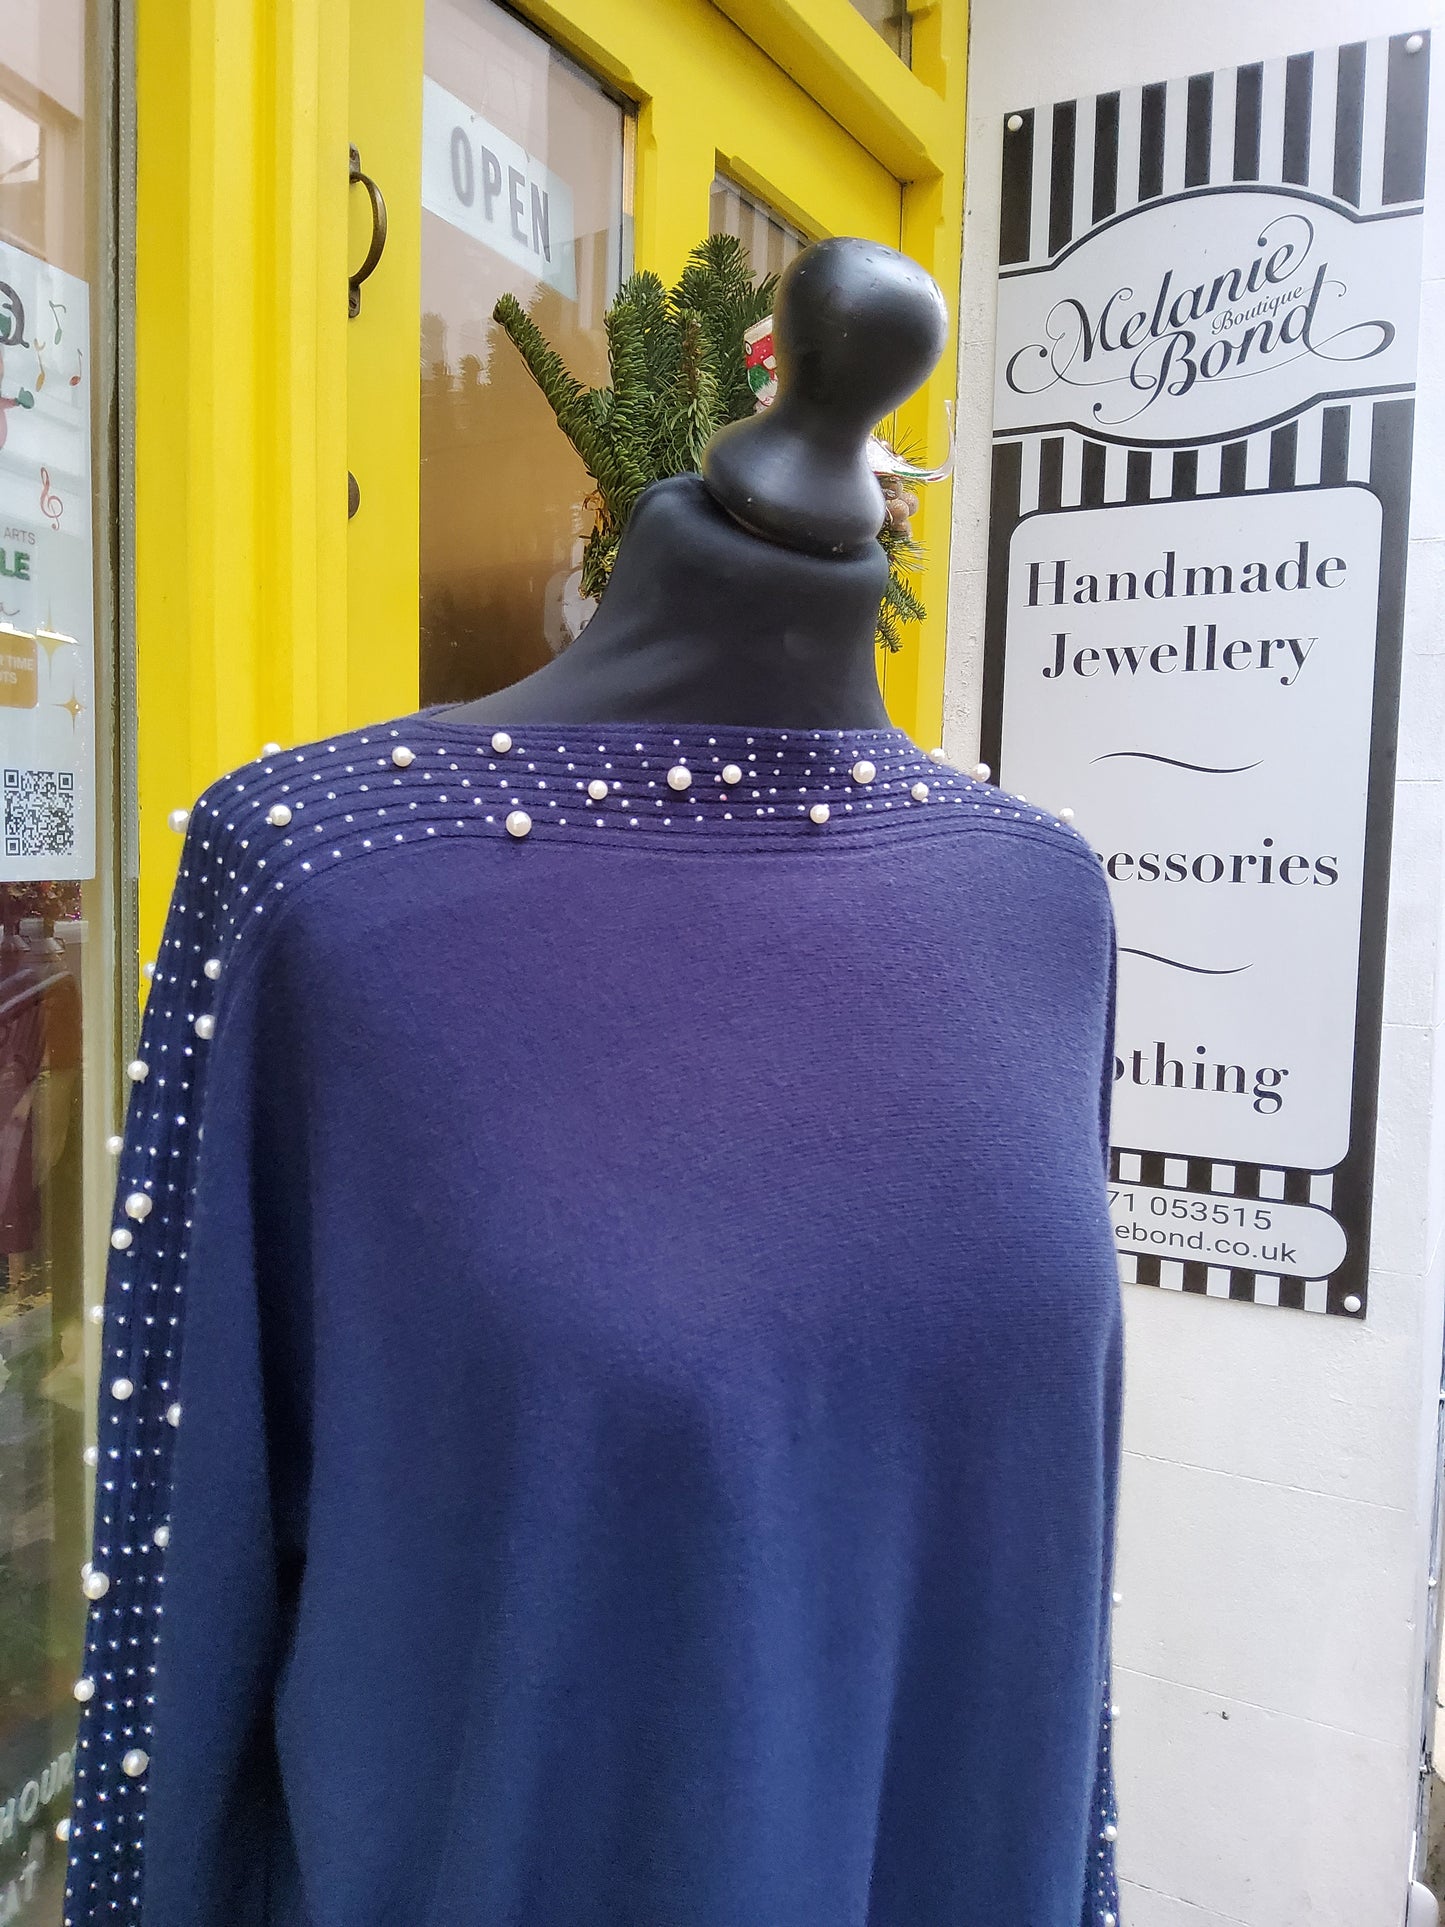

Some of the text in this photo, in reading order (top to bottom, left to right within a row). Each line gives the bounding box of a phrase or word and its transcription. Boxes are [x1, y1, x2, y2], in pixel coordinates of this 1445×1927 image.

[450, 125, 551, 263] OPEN
[1006, 214, 1314, 394] Melanie
[1211, 284, 1304, 335] Boutique
[1093, 262, 1396, 425] Bond
[4, 526, 36, 546] ARTS
[1022, 540, 1348, 608] Handmade
[1042, 624, 1320, 686] Jewellery
[1096, 837, 1339, 887] essories
[1150, 1196, 1273, 1230] 053515
[1114, 1221, 1297, 1264] ebond.co.uk
